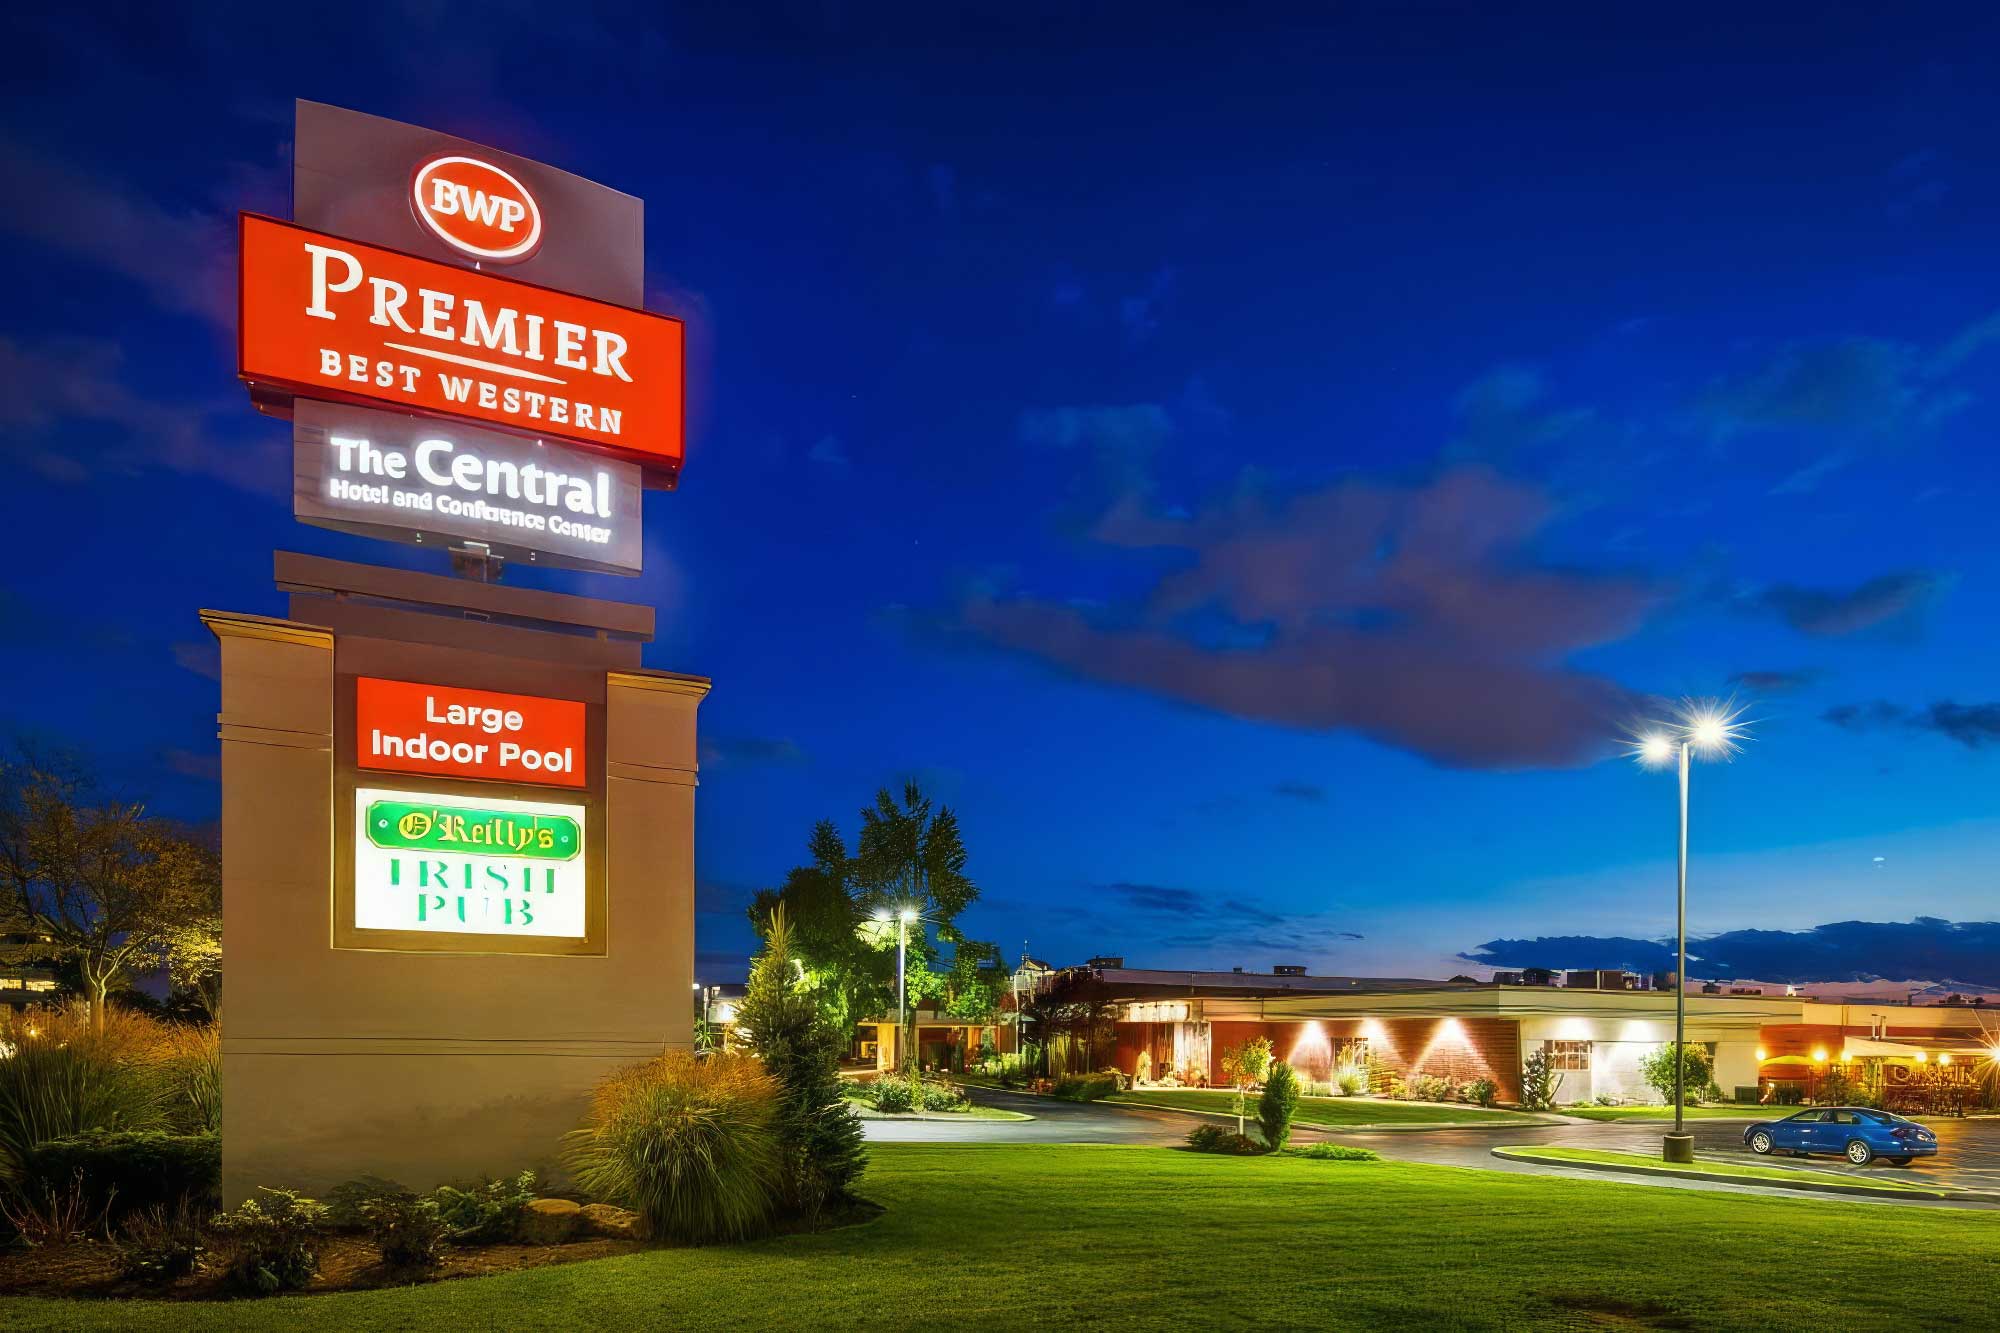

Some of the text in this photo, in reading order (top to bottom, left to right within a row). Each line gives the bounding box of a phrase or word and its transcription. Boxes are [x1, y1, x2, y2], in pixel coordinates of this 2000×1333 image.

[430, 178, 526, 233] BWP
[304, 242, 634, 383] PREMIER
[319, 348, 622, 435] BEST WESTERN
[330, 437, 611, 518] The Central
[329, 479, 612, 544] Hotel and Conference Center
[426, 696, 523, 734] Large
[372, 729, 572, 773] Indoor Pool
[398, 810, 555, 851] O'Reilly's
[418, 893, 535, 926] PUB
